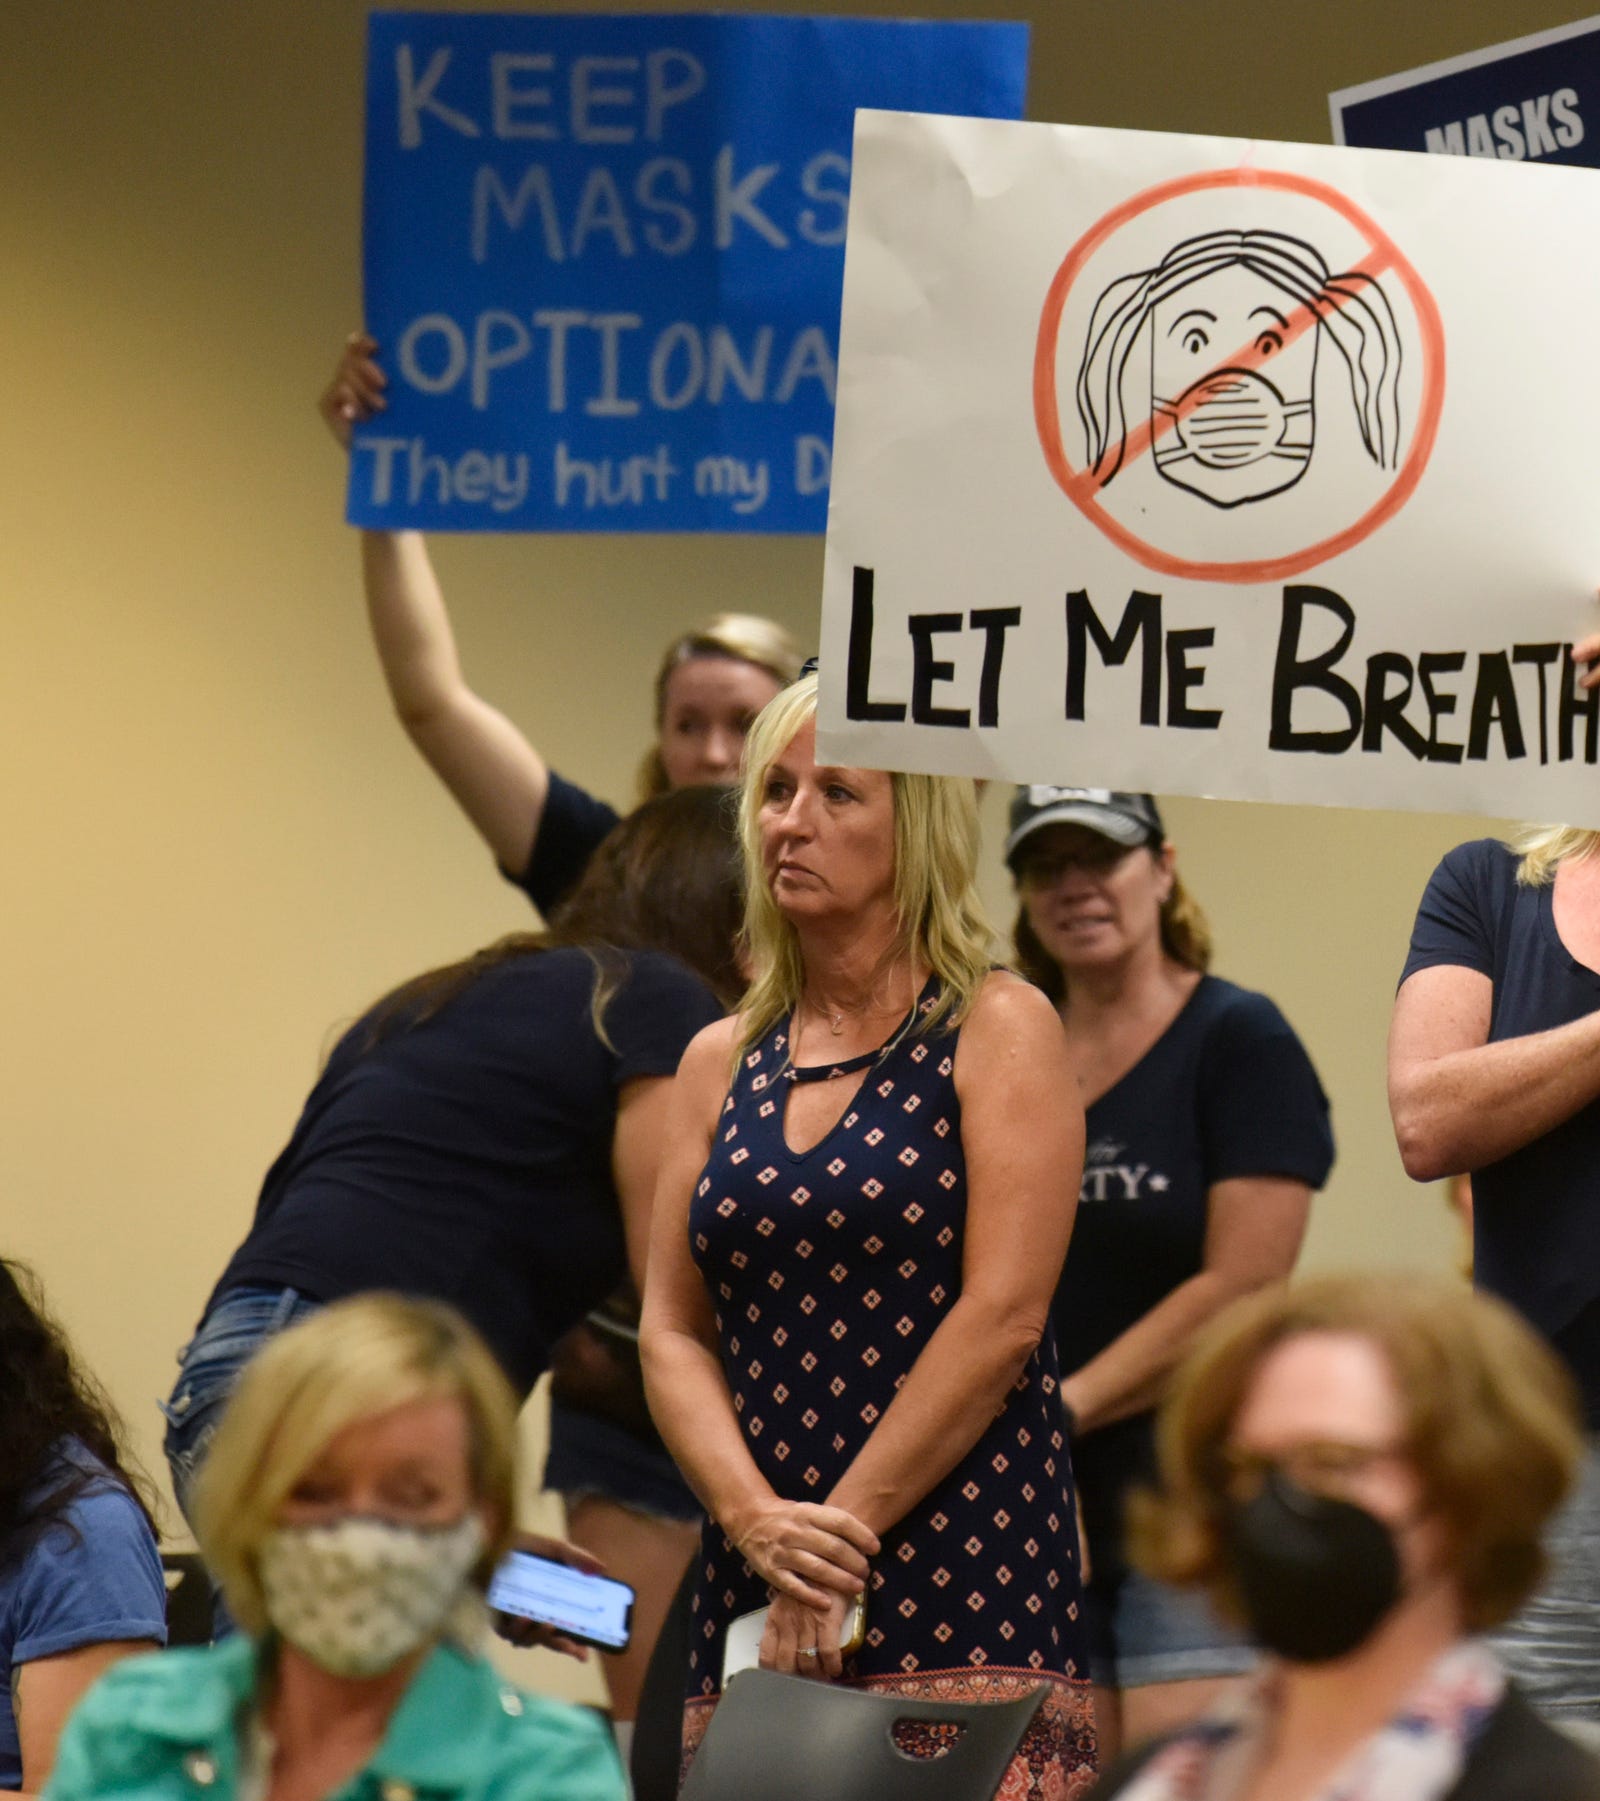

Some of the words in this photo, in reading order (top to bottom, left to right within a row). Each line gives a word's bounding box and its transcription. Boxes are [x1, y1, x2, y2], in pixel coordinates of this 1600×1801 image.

[396, 44, 706, 149] KEEP
[469, 143, 850, 263] MASKS
[399, 309, 838, 416] OPTIONA
[357, 436, 530, 512] They
[555, 441, 676, 509] hurt
[694, 454, 768, 513] my
[845, 566, 1021, 729] LET
